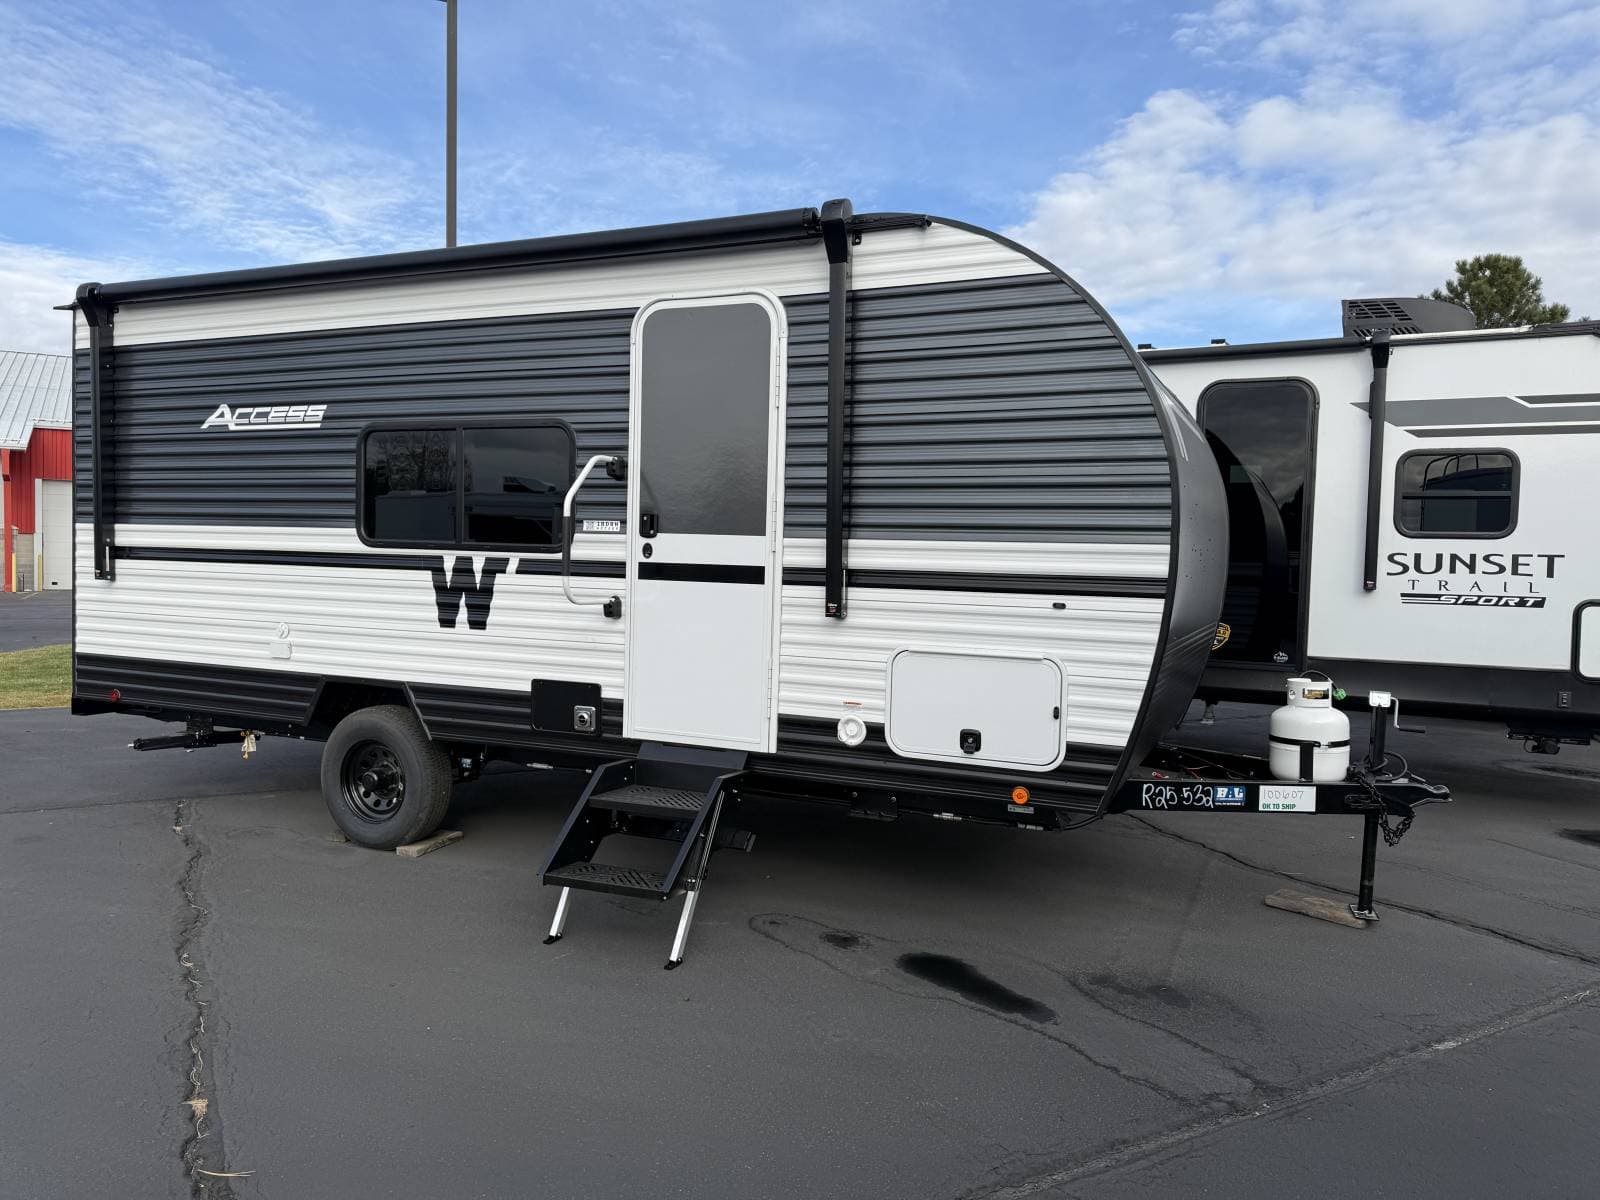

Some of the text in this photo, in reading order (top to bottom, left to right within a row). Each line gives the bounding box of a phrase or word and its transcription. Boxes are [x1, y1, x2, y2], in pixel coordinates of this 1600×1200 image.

[201, 403, 328, 431] ACCESS
[1386, 552, 1565, 578] SUNSET
[1408, 579, 1540, 593] TRAIL
[1438, 595, 1543, 607] SPORT
